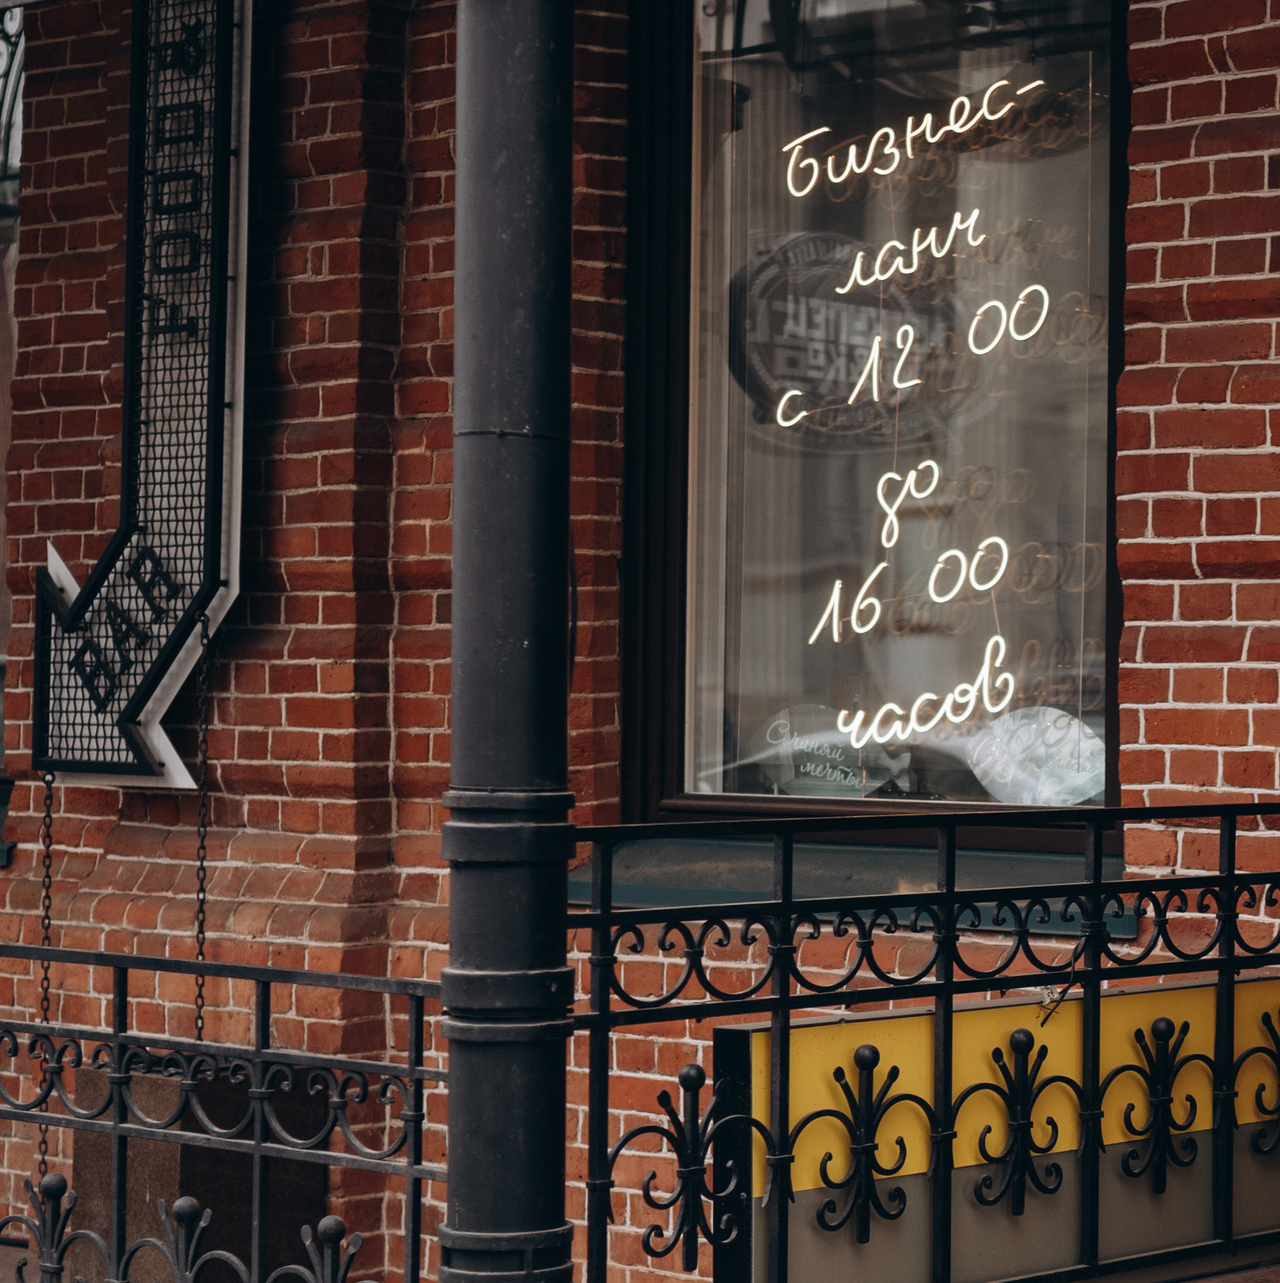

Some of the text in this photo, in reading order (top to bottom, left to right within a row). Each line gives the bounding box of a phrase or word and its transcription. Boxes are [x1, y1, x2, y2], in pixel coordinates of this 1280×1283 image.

[781, 79, 1046, 199] Бизнес-
[835, 207, 987, 295] ланч
[846, 323, 923, 406] 12
[967, 284, 1050, 356] 00
[876, 459, 940, 549] до
[808, 535, 1009, 646] 16 00
[836, 634, 1016, 750] часов
